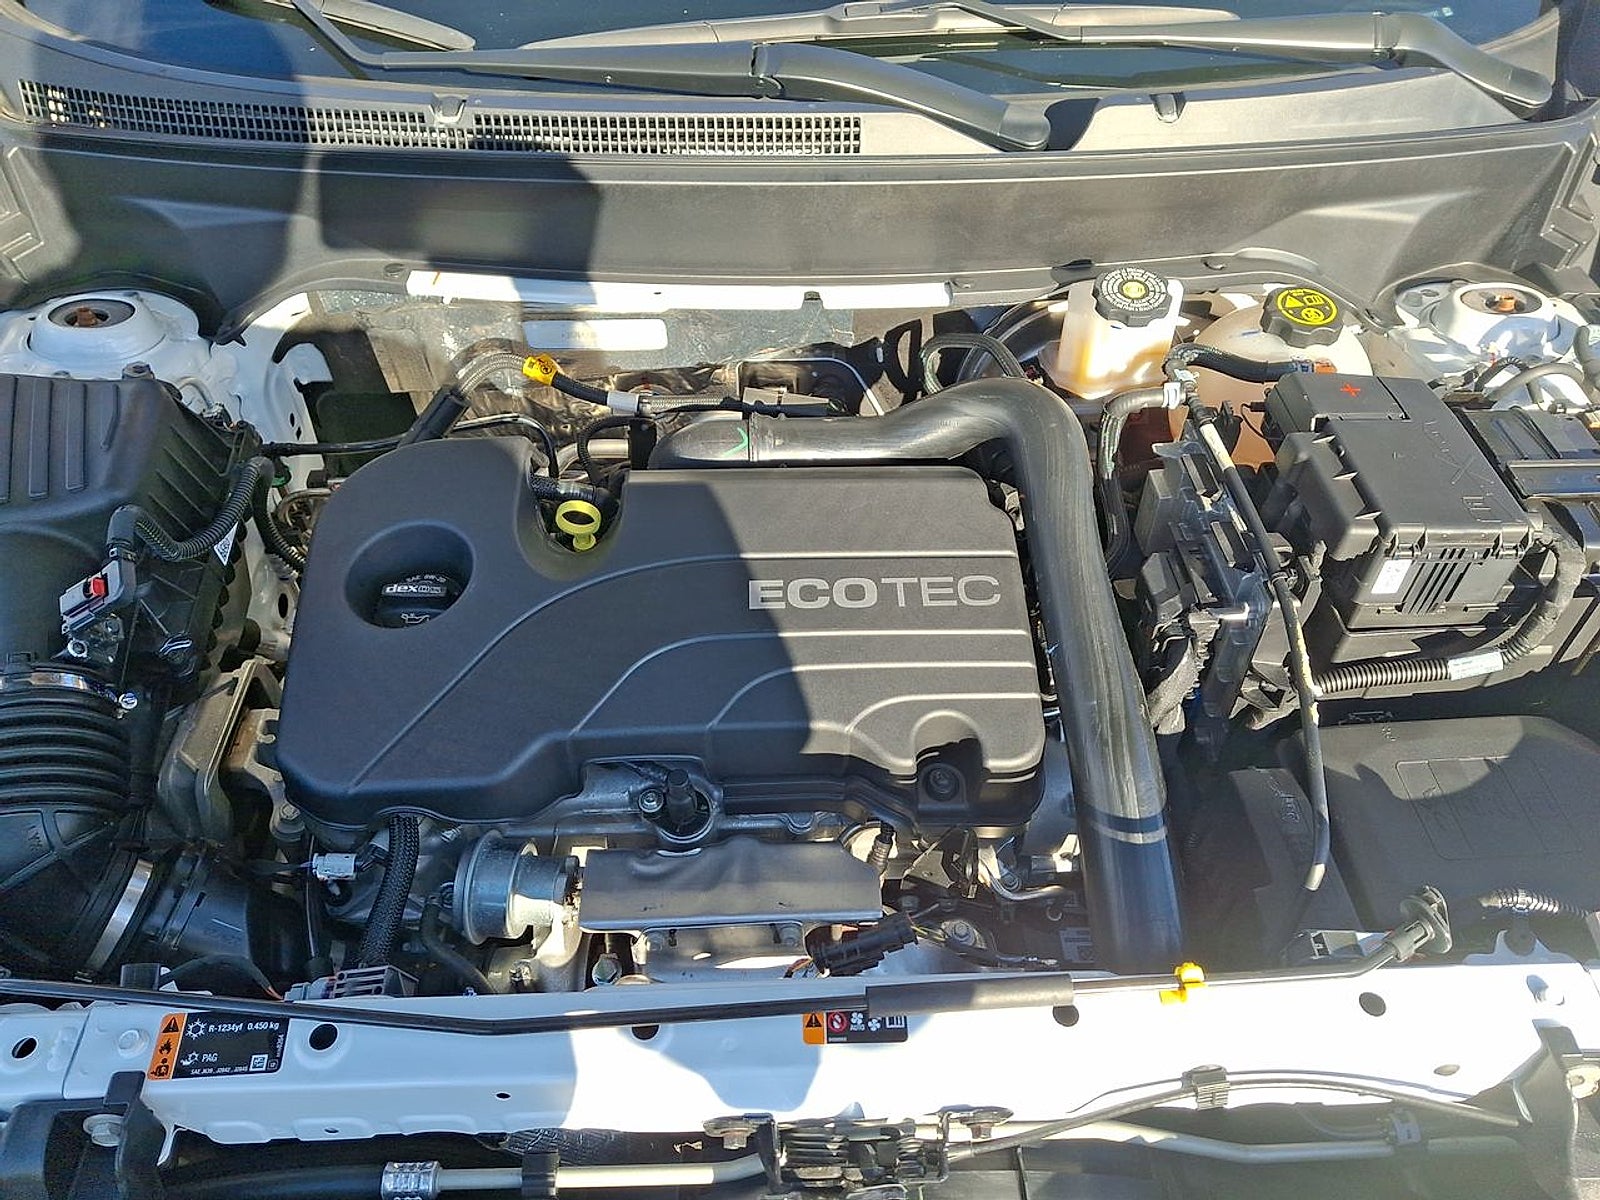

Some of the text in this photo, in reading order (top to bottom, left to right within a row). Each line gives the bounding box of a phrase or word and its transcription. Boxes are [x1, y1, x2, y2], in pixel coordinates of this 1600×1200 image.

[748, 574, 1002, 610] ECOTEC
[208, 1021, 280, 1034] R-1234yf 0.450 kg
[201, 1053, 219, 1063] PAG
